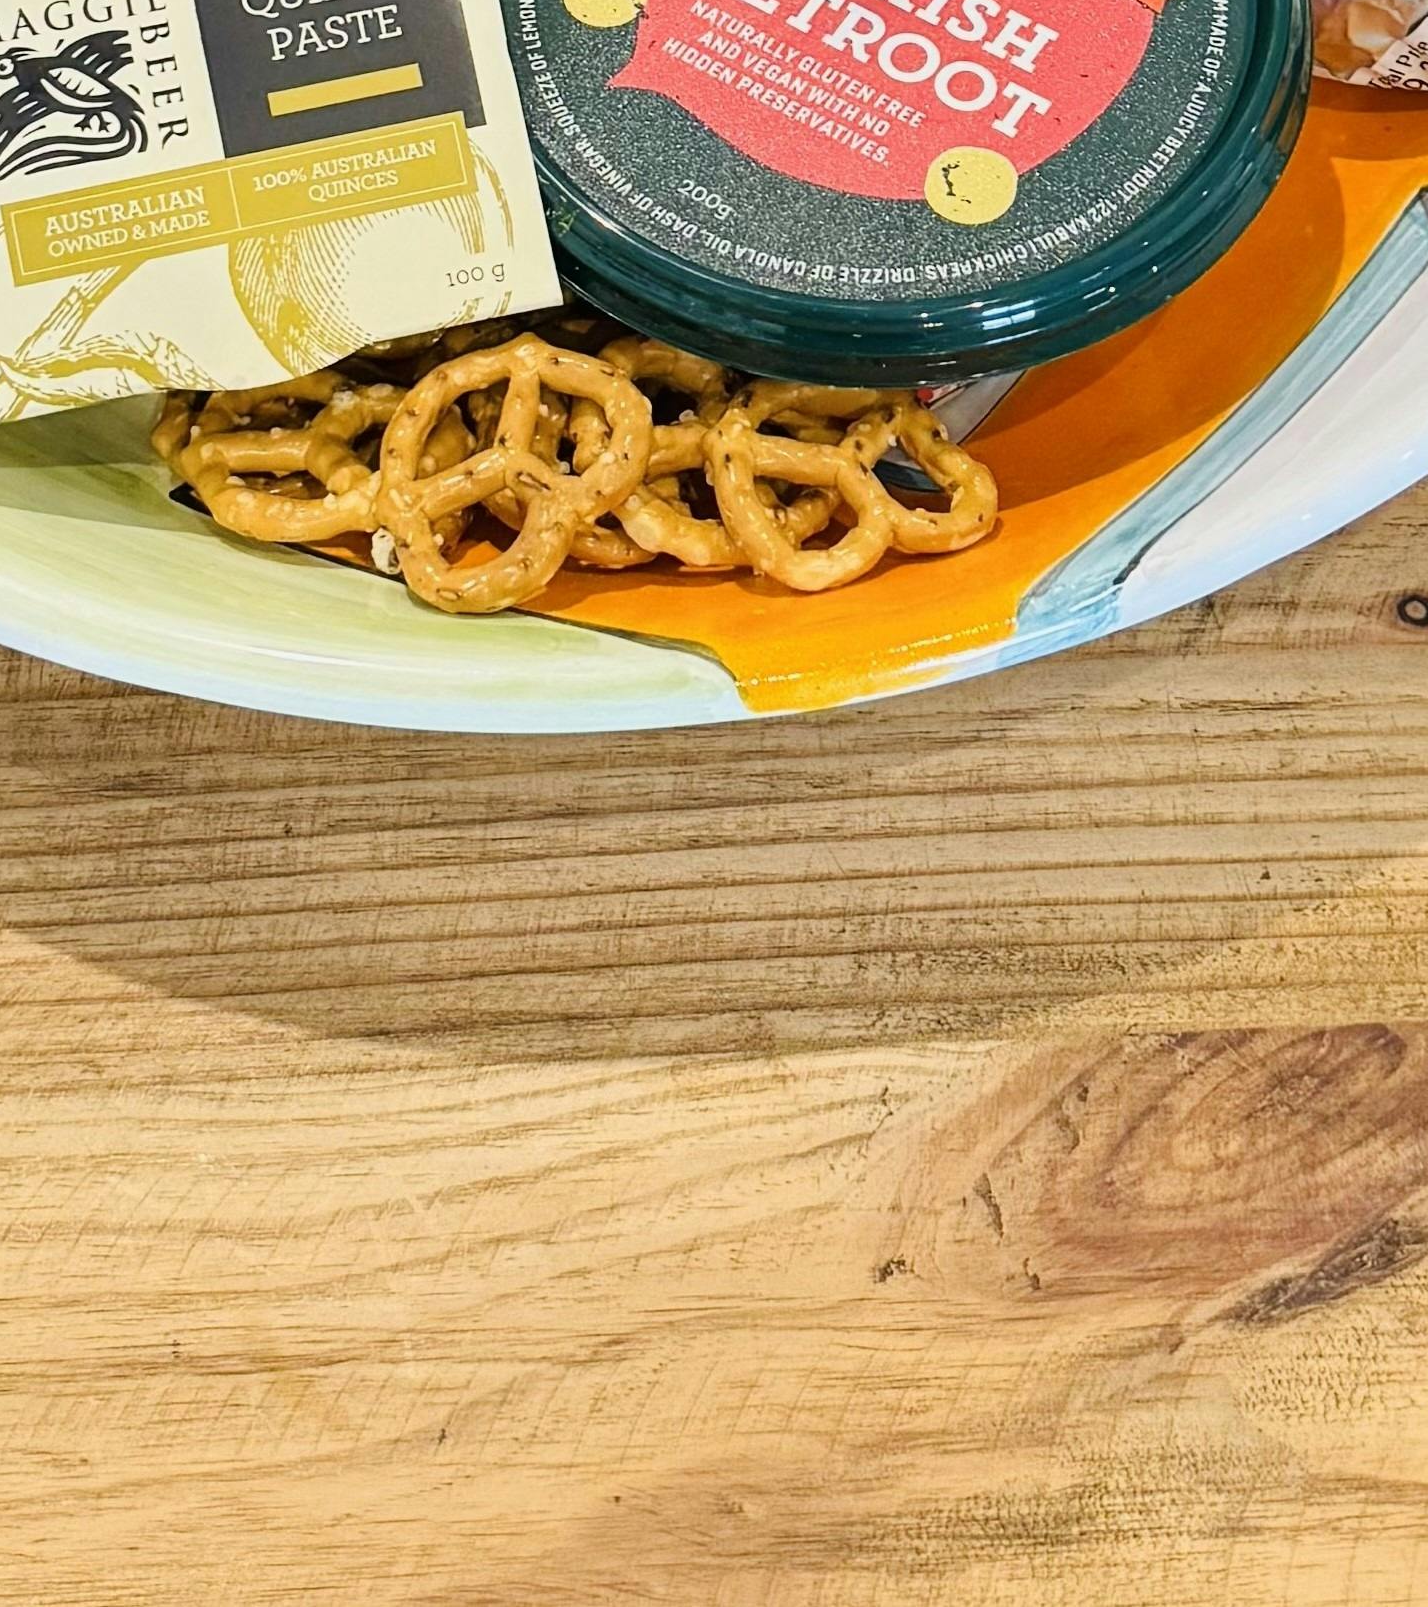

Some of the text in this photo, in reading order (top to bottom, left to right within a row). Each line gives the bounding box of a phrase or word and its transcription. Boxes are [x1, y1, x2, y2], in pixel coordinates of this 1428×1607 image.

[266, 3, 403, 61] PASTE
[1206, 15, 1230, 57] MADE
[526, 51, 548, 72] OF
[690, 0, 927, 128] NATURALLY GLUTEN FREE
[139, 21, 190, 150] BEER
[533, 71, 582, 138] SQUEEZE
[661, 36, 892, 167] HIDDEN PRESERVATIVES.
[697, 30, 892, 137] AND VEGAN WITH NO
[1196, 80, 1213, 95] A
[1171, 93, 1208, 141] JUICY
[252, 139, 438, 193] 100% AUSTRALIAN
[307, 169, 400, 204] QUINCES
[44, 185, 207, 237] AUSTRALIAN
[628, 191, 655, 217] OF
[677, 178, 736, 222] 200g
[47, 210, 212, 260] OWNED & MADE
[650, 204, 700, 240] DASH
[1031, 213, 1093, 255] KABULI
[445, 262, 507, 289] 100 g
[732, 246, 806, 278] CANOLA
[810, 264, 834, 282] OF
[838, 265, 917, 284] DRIZZLE
